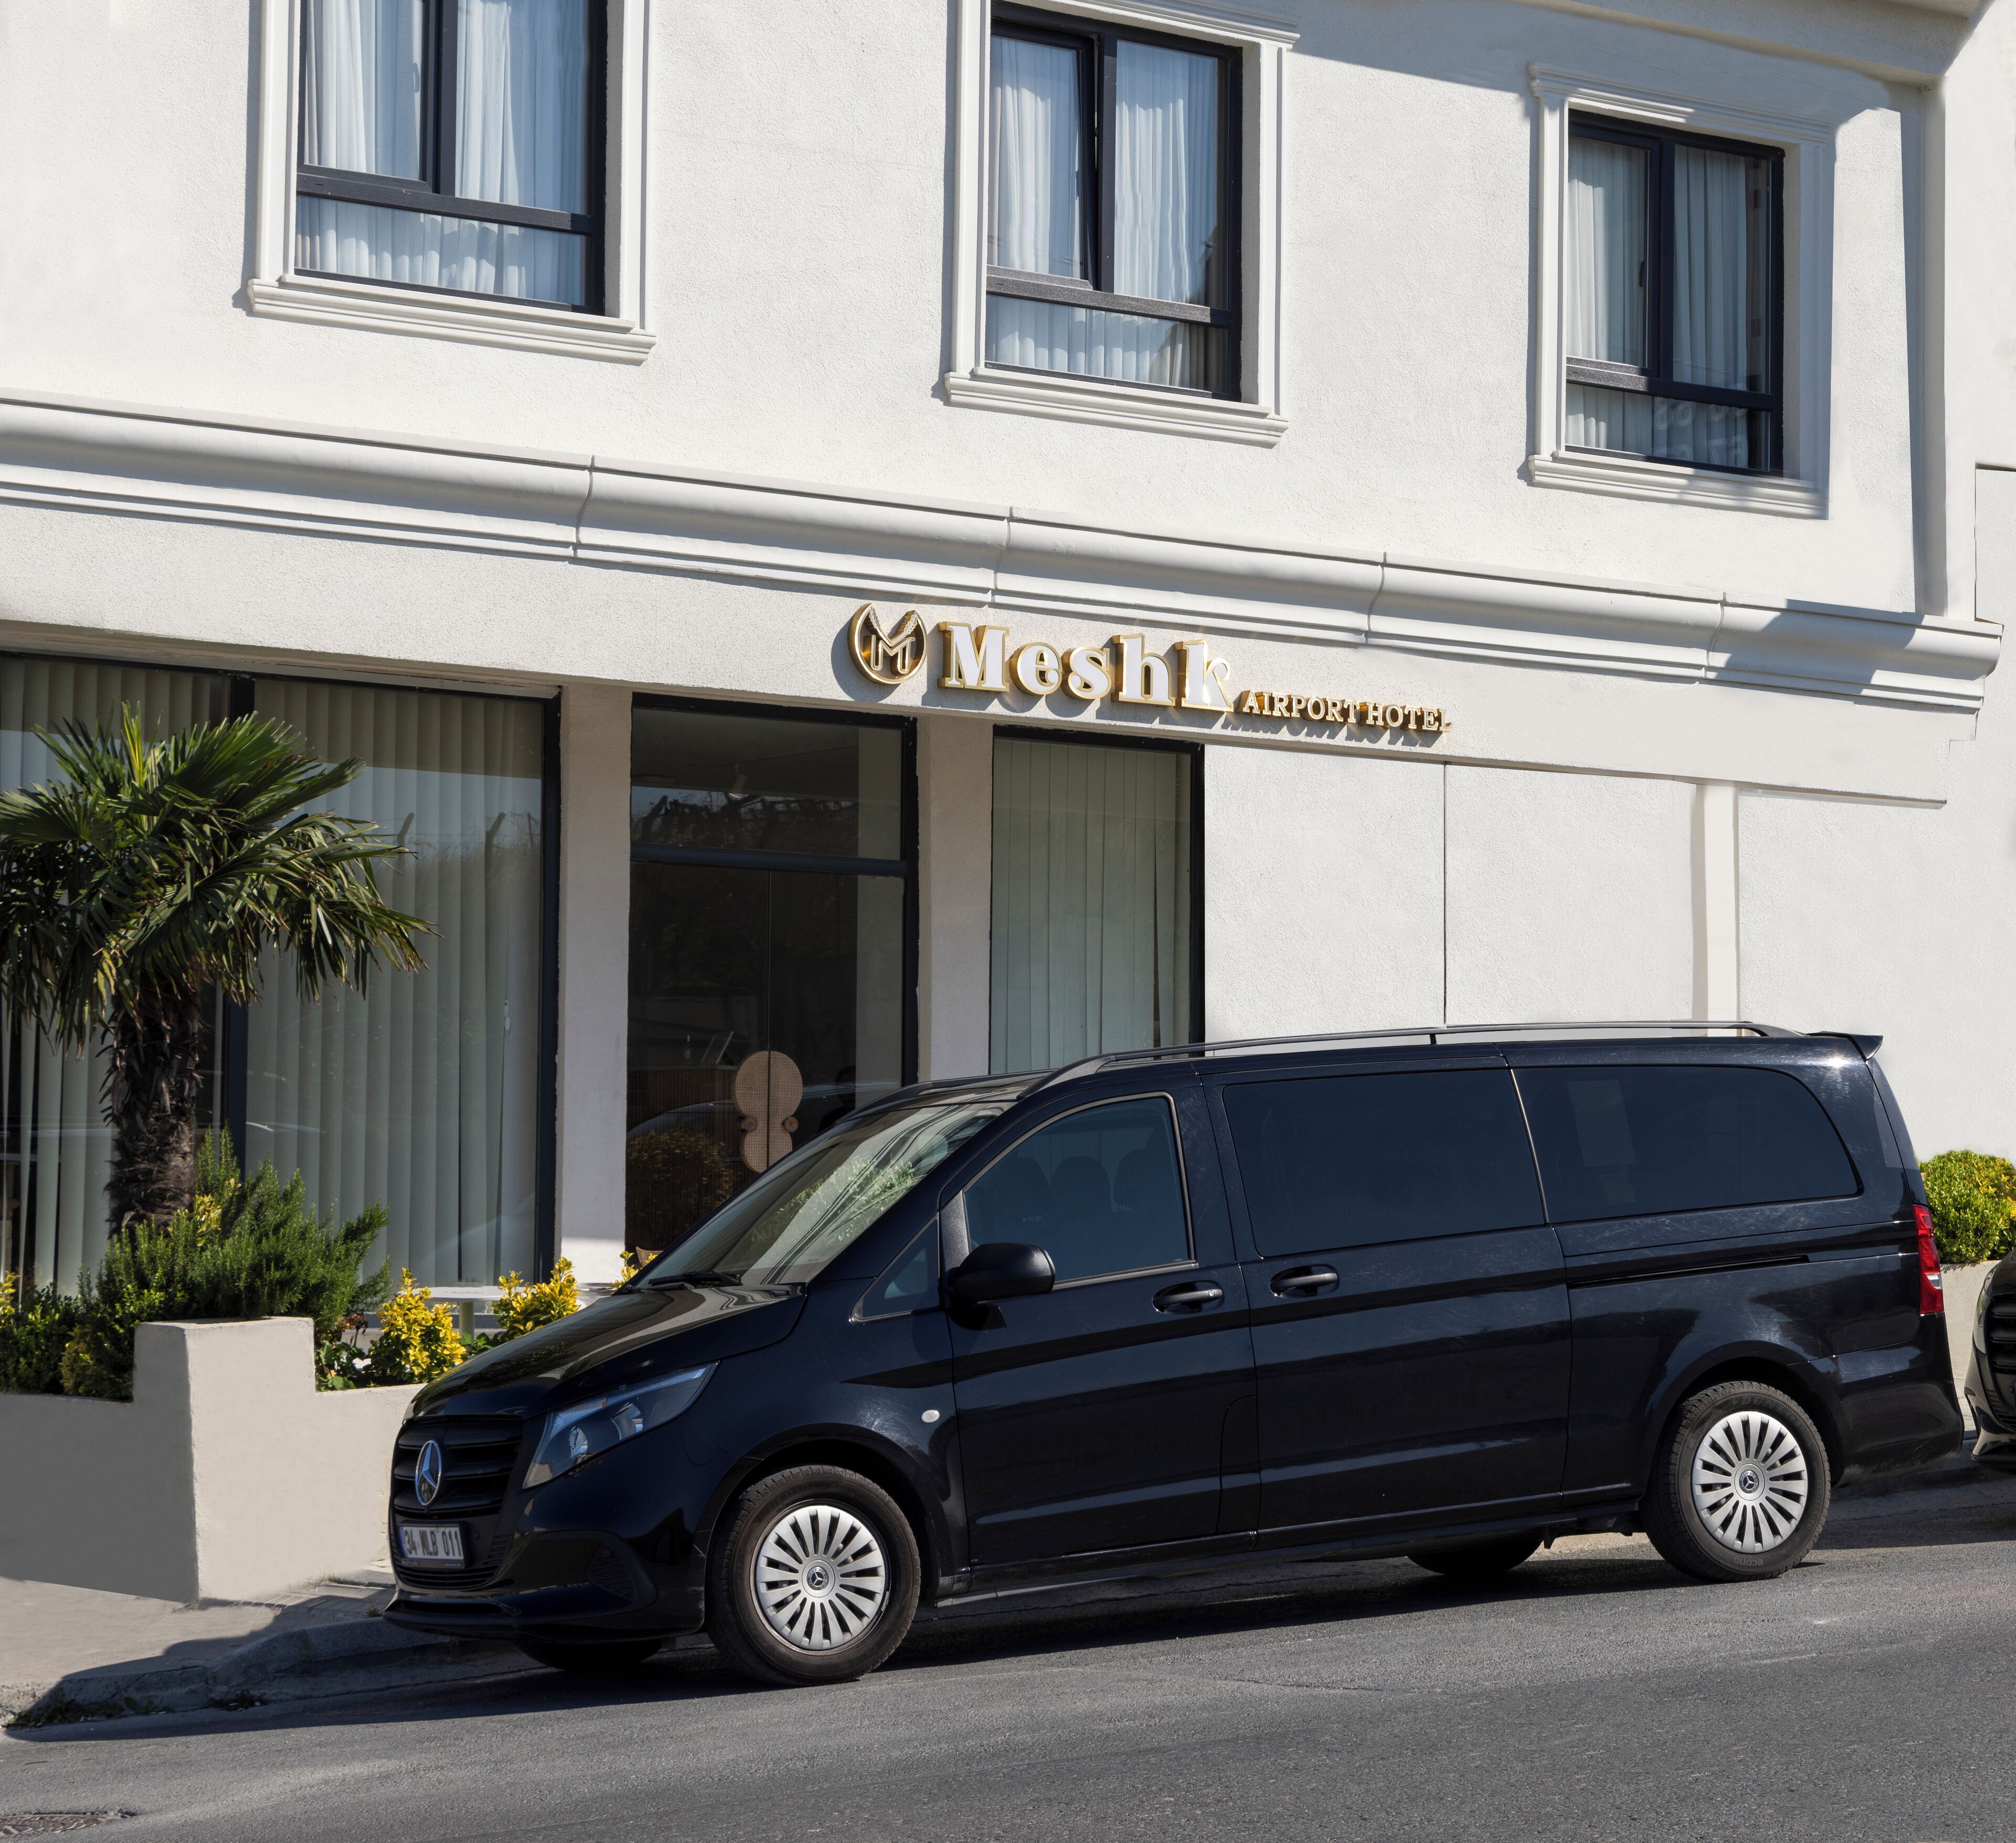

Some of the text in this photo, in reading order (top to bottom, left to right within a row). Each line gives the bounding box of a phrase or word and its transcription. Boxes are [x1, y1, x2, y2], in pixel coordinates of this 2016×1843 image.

[938, 621, 1453, 732] Meshk AIRPORT HOTEL
[404, 1529, 417, 1555] 34
[442, 1530, 462, 1557] 011
